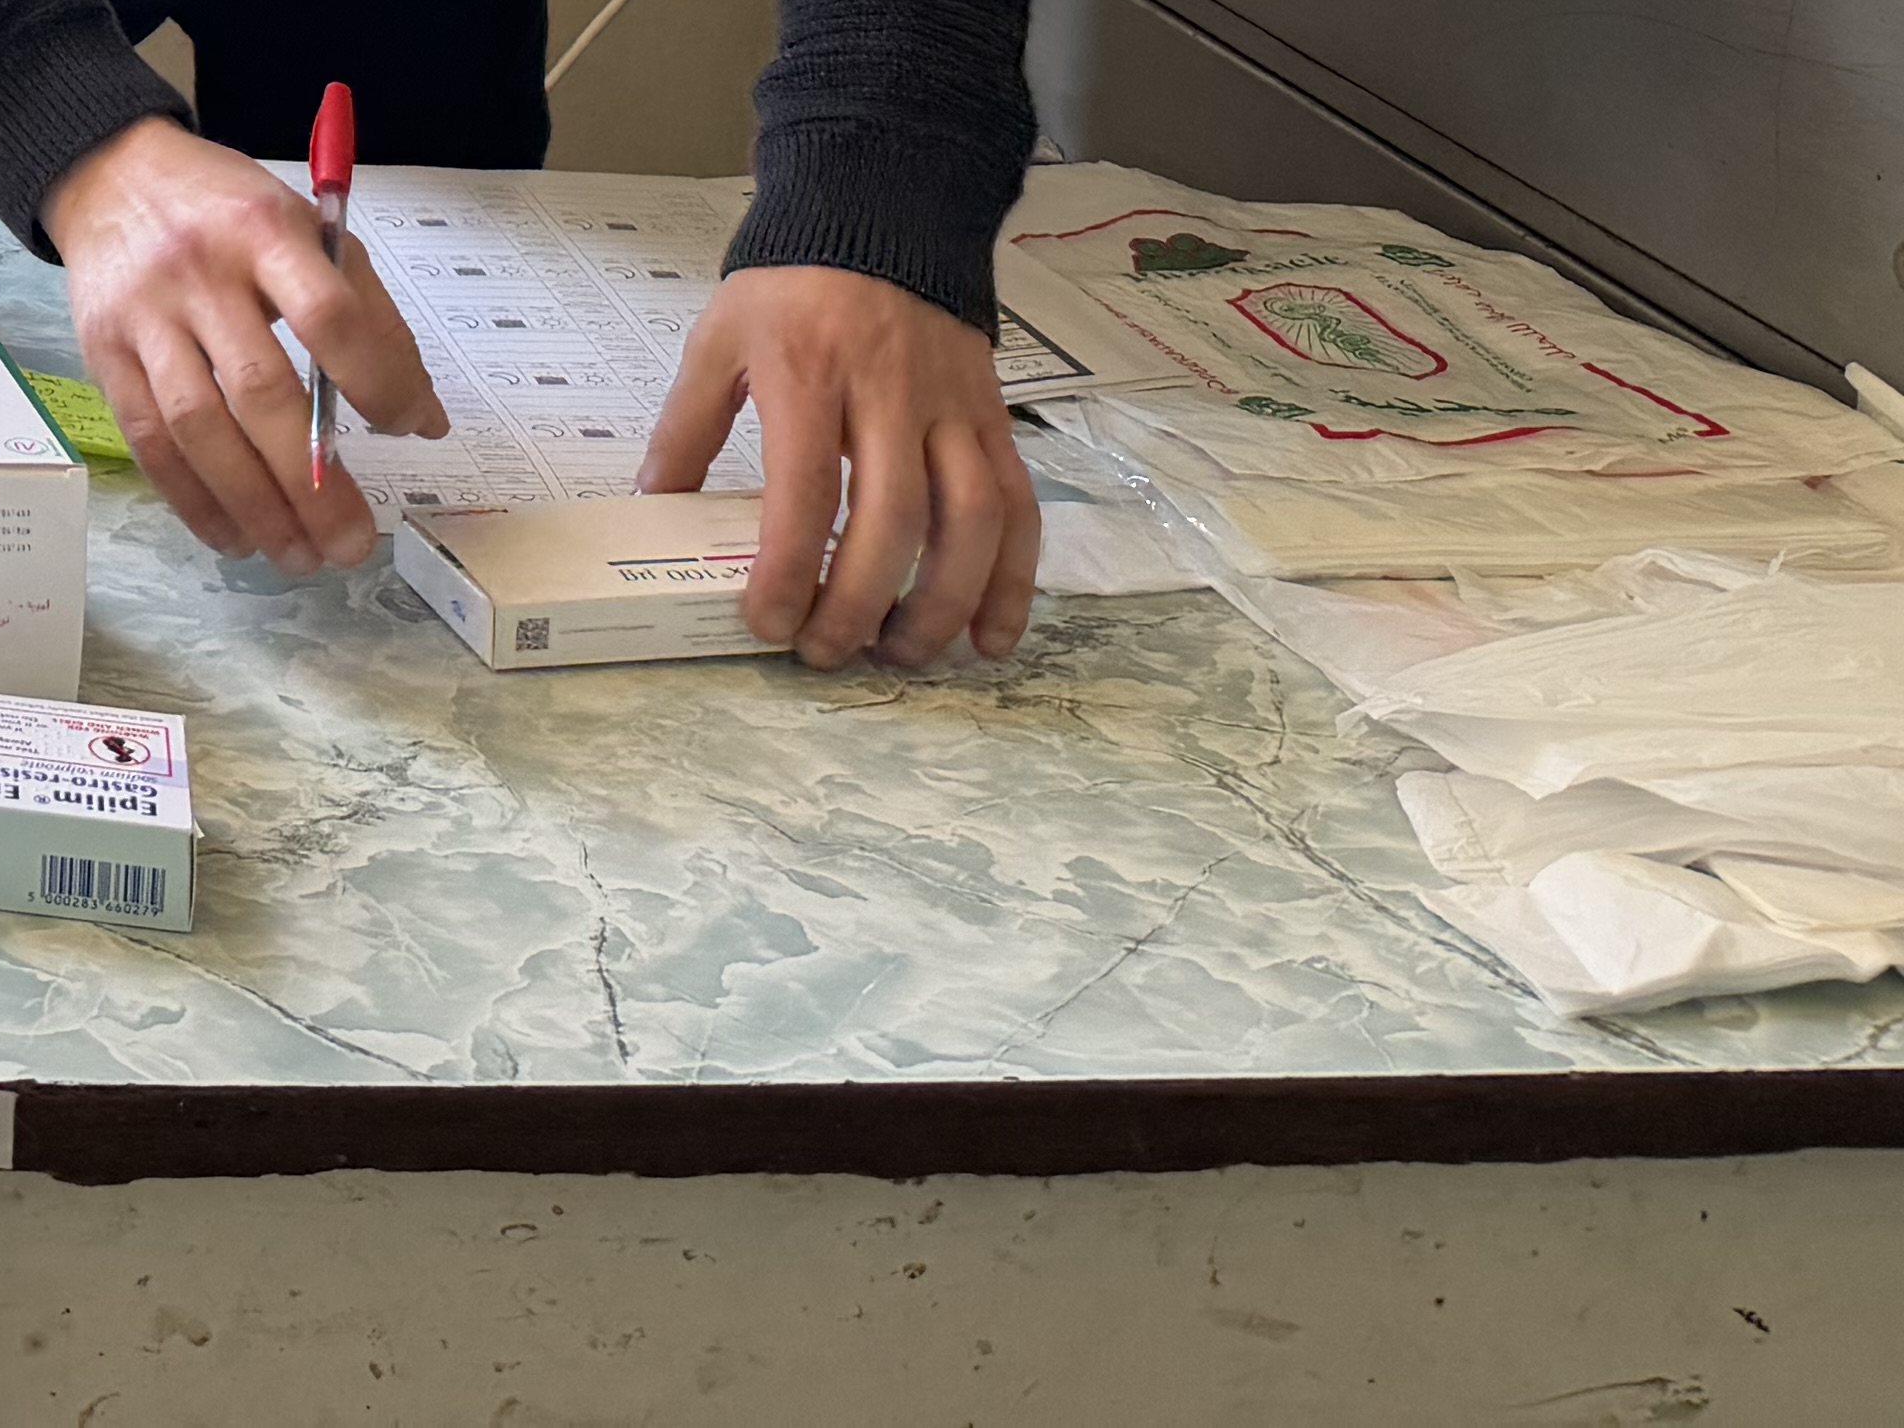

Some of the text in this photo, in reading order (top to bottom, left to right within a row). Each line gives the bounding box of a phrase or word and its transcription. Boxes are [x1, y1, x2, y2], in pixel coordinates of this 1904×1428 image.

[667, 568, 717, 582] 100
[20, 758, 159, 785] sodium valproate
[27, 891, 161, 918] 5 000283 660279
